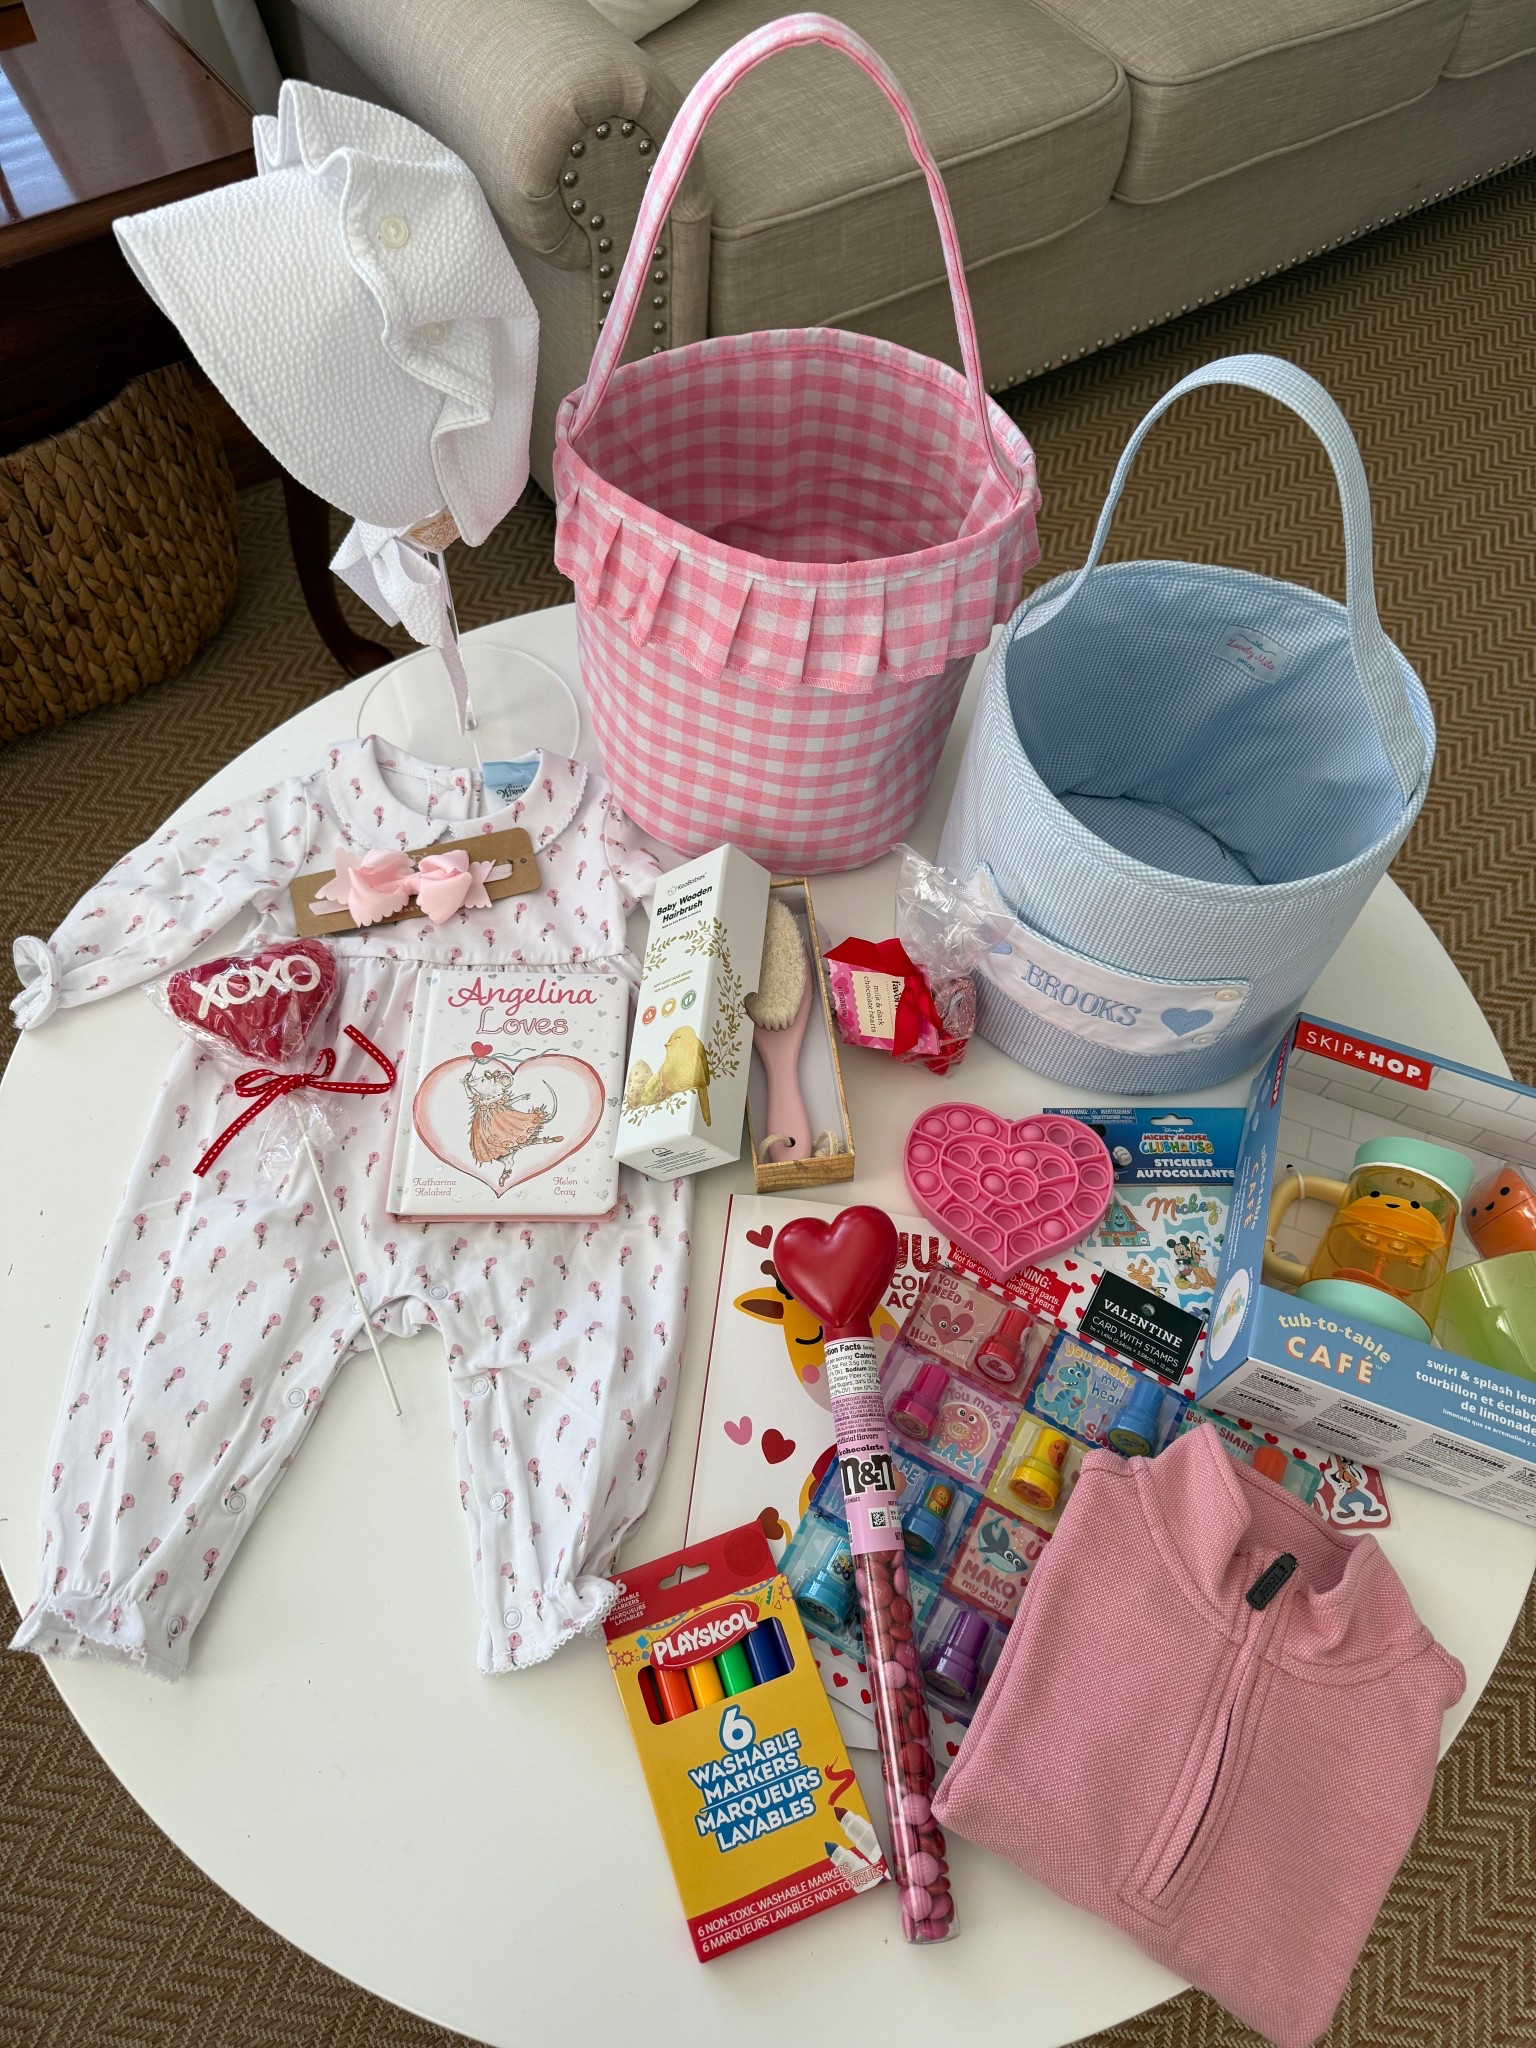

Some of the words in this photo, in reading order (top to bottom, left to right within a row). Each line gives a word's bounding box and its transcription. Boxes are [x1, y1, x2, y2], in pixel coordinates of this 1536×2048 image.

[656, 901, 677, 917] Baby
[679, 885, 713, 905] Wooden
[662, 899, 703, 923] Hairbrush
[190, 955, 321, 1020] XOXO
[448, 976, 597, 1017] Angelina
[1020, 959, 1142, 1027] BROOKS
[863, 975, 873, 1010] chocolate
[868, 1010, 877, 1033] hearts
[876, 1009, 885, 1027] dark
[476, 1006, 569, 1035] Loves
[1139, 1141, 1214, 1154] CLUBHOUSE
[1142, 1133, 1175, 1141] MICKEY
[1177, 1133, 1208, 1141] MOUSE
[1136, 1169, 1235, 1178] AUTOCOLLANTS
[1154, 1158, 1214, 1168] STICKERS
[412, 1177, 457, 1187] Katharine
[414, 1187, 452, 1197] Holabird
[552, 1176, 578, 1186] Helen
[553, 1186, 576, 1198] Craig
[1146, 1193, 1221, 1225] Mickey
[952, 1252, 967, 1264] Not
[966, 1260, 977, 1269] for
[938, 1273, 959, 1291] YOU
[1019, 1267, 1052, 1290] NING:
[931, 1285, 962, 1305] NEED
[963, 1299, 974, 1312] A
[1006, 1281, 1028, 1297] under
[1034, 1296, 1056, 1313] years.
[1039, 1290, 1060, 1307] parts.
[909, 1326, 937, 1348] HUG
[1104, 1298, 1183, 1348] VALENTINE
[840, 1343, 861, 1352] Facts
[1092, 1316, 1118, 1334] CARD
[1119, 1329, 1143, 1347] WITH
[1143, 1343, 1180, 1368] STAMPS
[1278, 1312, 1391, 1364] tub-to-table
[1064, 1342, 1093, 1363] you
[1093, 1356, 1136, 1388] make
[1286, 1336, 1373, 1385] CAFÉ
[1101, 1373, 1120, 1391] my
[1426, 1360, 1457, 1377] swirl
[1460, 1370, 1470, 1382] &
[1473, 1376, 1513, 1397] splash
[1091, 1381, 1122, 1406] hear
[1415, 1370, 1478, 1401] tourbillon
[1480, 1395, 1494, 1407] et
[1496, 1400, 1536, 1422] éclabo
[973, 1397, 1001, 1430] make
[1442, 1408, 1471, 1424] limonada
[1471, 1419, 1484, 1428] que
[1492, 1427, 1526, 1444] arremolina
[1460, 1401, 1477, 1414] de
[1479, 1406, 1536, 1436] limonade
[857, 1432, 879, 1442] flavors
[949, 1422, 970, 1435] me
[1218, 1427, 1254, 1454] SHARP
[842, 1444, 885, 1455] chocolate
[900, 1457, 920, 1486] ME
[614, 1578, 627, 1596] 6
[962, 1559, 1016, 1599] MAKO
[611, 1598, 640, 1612] MARKERS
[612, 1591, 640, 1605] ASHABLE
[961, 1579, 978, 1594] my
[979, 1590, 1009, 1612] day!
[609, 1603, 647, 1622] MARQUEURS
[614, 1610, 644, 1626] LAVABLES
[652, 1608, 757, 1666] PLAYSKOOL
[721, 1706, 754, 1751] 6
[690, 1730, 800, 1787] WASHABLE
[703, 1752, 799, 1805] MARKERS
[697, 1769, 821, 1834] MARQUEURS
[717, 1796, 814, 1850] LAVABLES
[697, 1926, 705, 1937] 6
[704, 1902, 758, 1934] NON-TOXIC
[757, 1882, 808, 1912] WASHABLE
[808, 1861, 850, 1889] MARKERS
[702, 1941, 710, 1952] 6
[710, 1915, 769, 1950] MARQUEURS
[771, 1895, 815, 1924] LAVABLES
